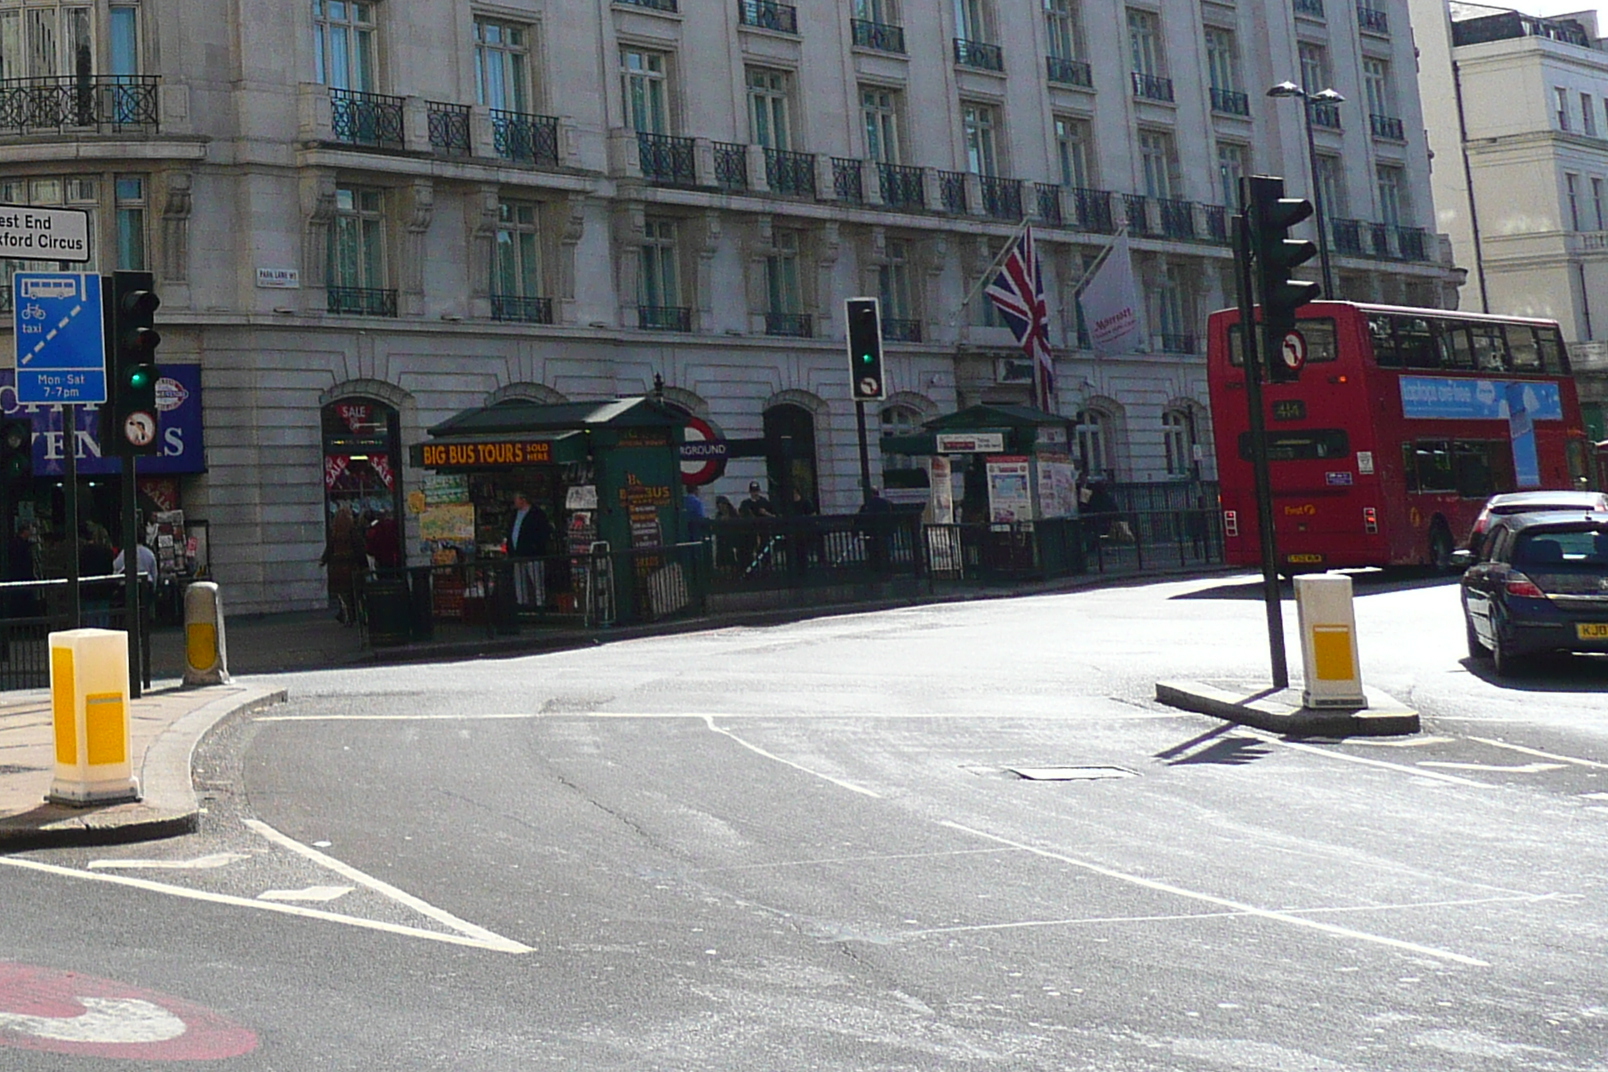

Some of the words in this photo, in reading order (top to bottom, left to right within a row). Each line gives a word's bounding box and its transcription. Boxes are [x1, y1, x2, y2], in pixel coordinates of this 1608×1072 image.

[25, 215, 51, 229] End
[38, 234, 83, 250] Circus
[22, 323, 42, 333] taxi
[342, 407, 366, 417] SALE
[423, 446, 446, 465] BIG
[449, 445, 475, 464] BUS
[478, 443, 523, 463] TOURS
[527, 443, 549, 452] SOLD
[527, 453, 549, 462] HERE
[326, 457, 346, 487] SALE
[372, 456, 393, 485] SALE
